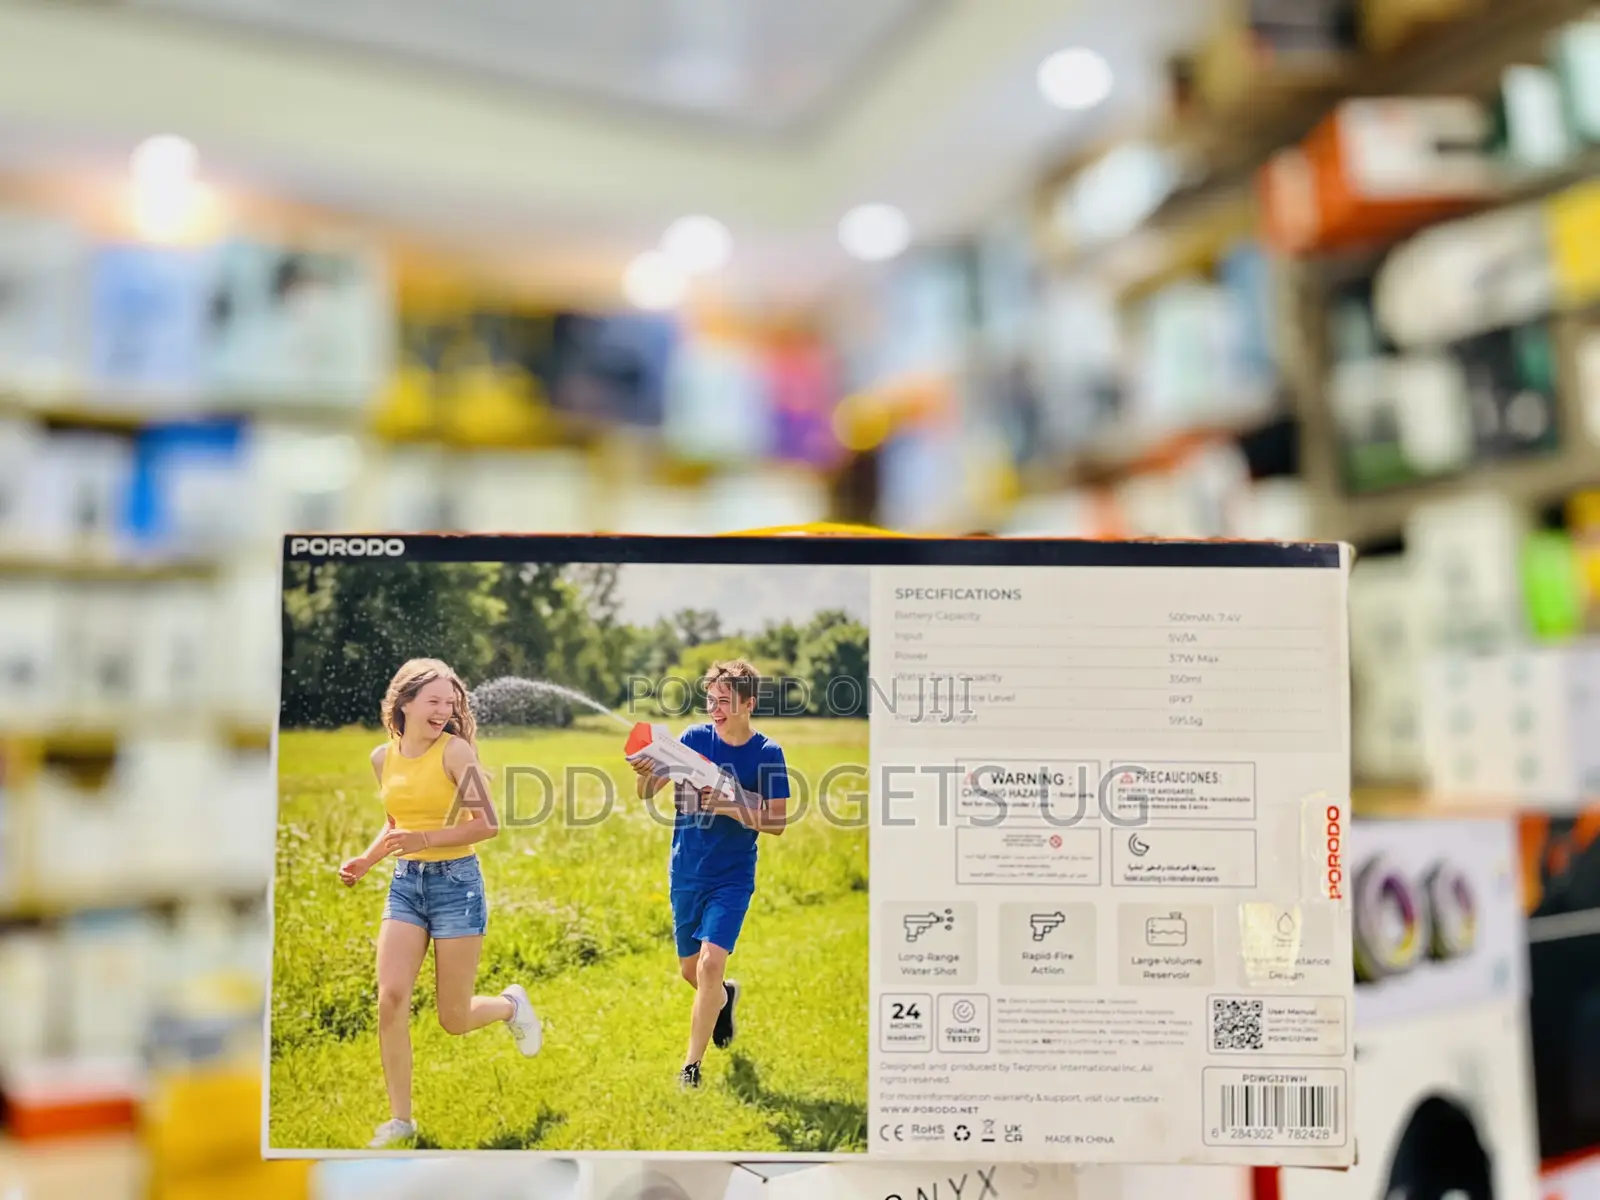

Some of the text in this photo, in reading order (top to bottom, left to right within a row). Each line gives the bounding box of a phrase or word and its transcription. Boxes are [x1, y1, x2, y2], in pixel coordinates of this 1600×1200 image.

[290, 537, 406, 557] PORODO
[894, 587, 1022, 601] SPECIFICATIONS
[894, 610, 982, 623] Battery Capacity
[894, 631, 923, 642] Input
[894, 651, 928, 661] Power
[988, 692, 1016, 703] Level
[1168, 694, 1194, 704] IPX7
[1135, 771, 1223, 785] PRECAUCIONES:
[1326, 804, 1342, 900] PORODO
[897, 951, 961, 964] Long-Range
[1021, 950, 1075, 963] Rapid-Fire
[1130, 955, 1204, 968] Large-Volume
[900, 966, 958, 976] Water Shot
[1030, 964, 1066, 975] Action
[1142, 970, 1191, 981] Reservoir
[892, 1002, 922, 1020] 24
[1267, 1007, 1318, 1018] User Manual
[889, 1022, 923, 1030] MONTH
[945, 1027, 981, 1035] QUALITY
[946, 1035, 981, 1043] TESTED
[880, 1062, 926, 1073] Designed
[928, 1062, 948, 1071] and
[950, 1062, 998, 1073] produced
[998, 1063, 1011, 1073] by
[1059, 1062, 1121, 1072] International
[880, 1076, 908, 1086] rights
[880, 1092, 895, 1101] For
[922, 1092, 978, 1102] information
[979, 1094, 992, 1102] on
[993, 1094, 1035, 1104] warranty
[1084, 1094, 1104, 1104] visit
[1104, 1095, 1121, 1104] our
[1122, 1095, 1160, 1104] website
[880, 1105, 979, 1115] WWW.PORODO.NET
[911, 1123, 945, 1135] RoHS
[1003, 1123, 1022, 1134] UK
[1210, 1128, 1220, 1139] 6
[1230, 1128, 1274, 1140] 284302
[1044, 1134, 1116, 1144] MADE IN CHINA
[1287, 1129, 1330, 1141] 782428
[884, 1165, 999, 1200] NYX
